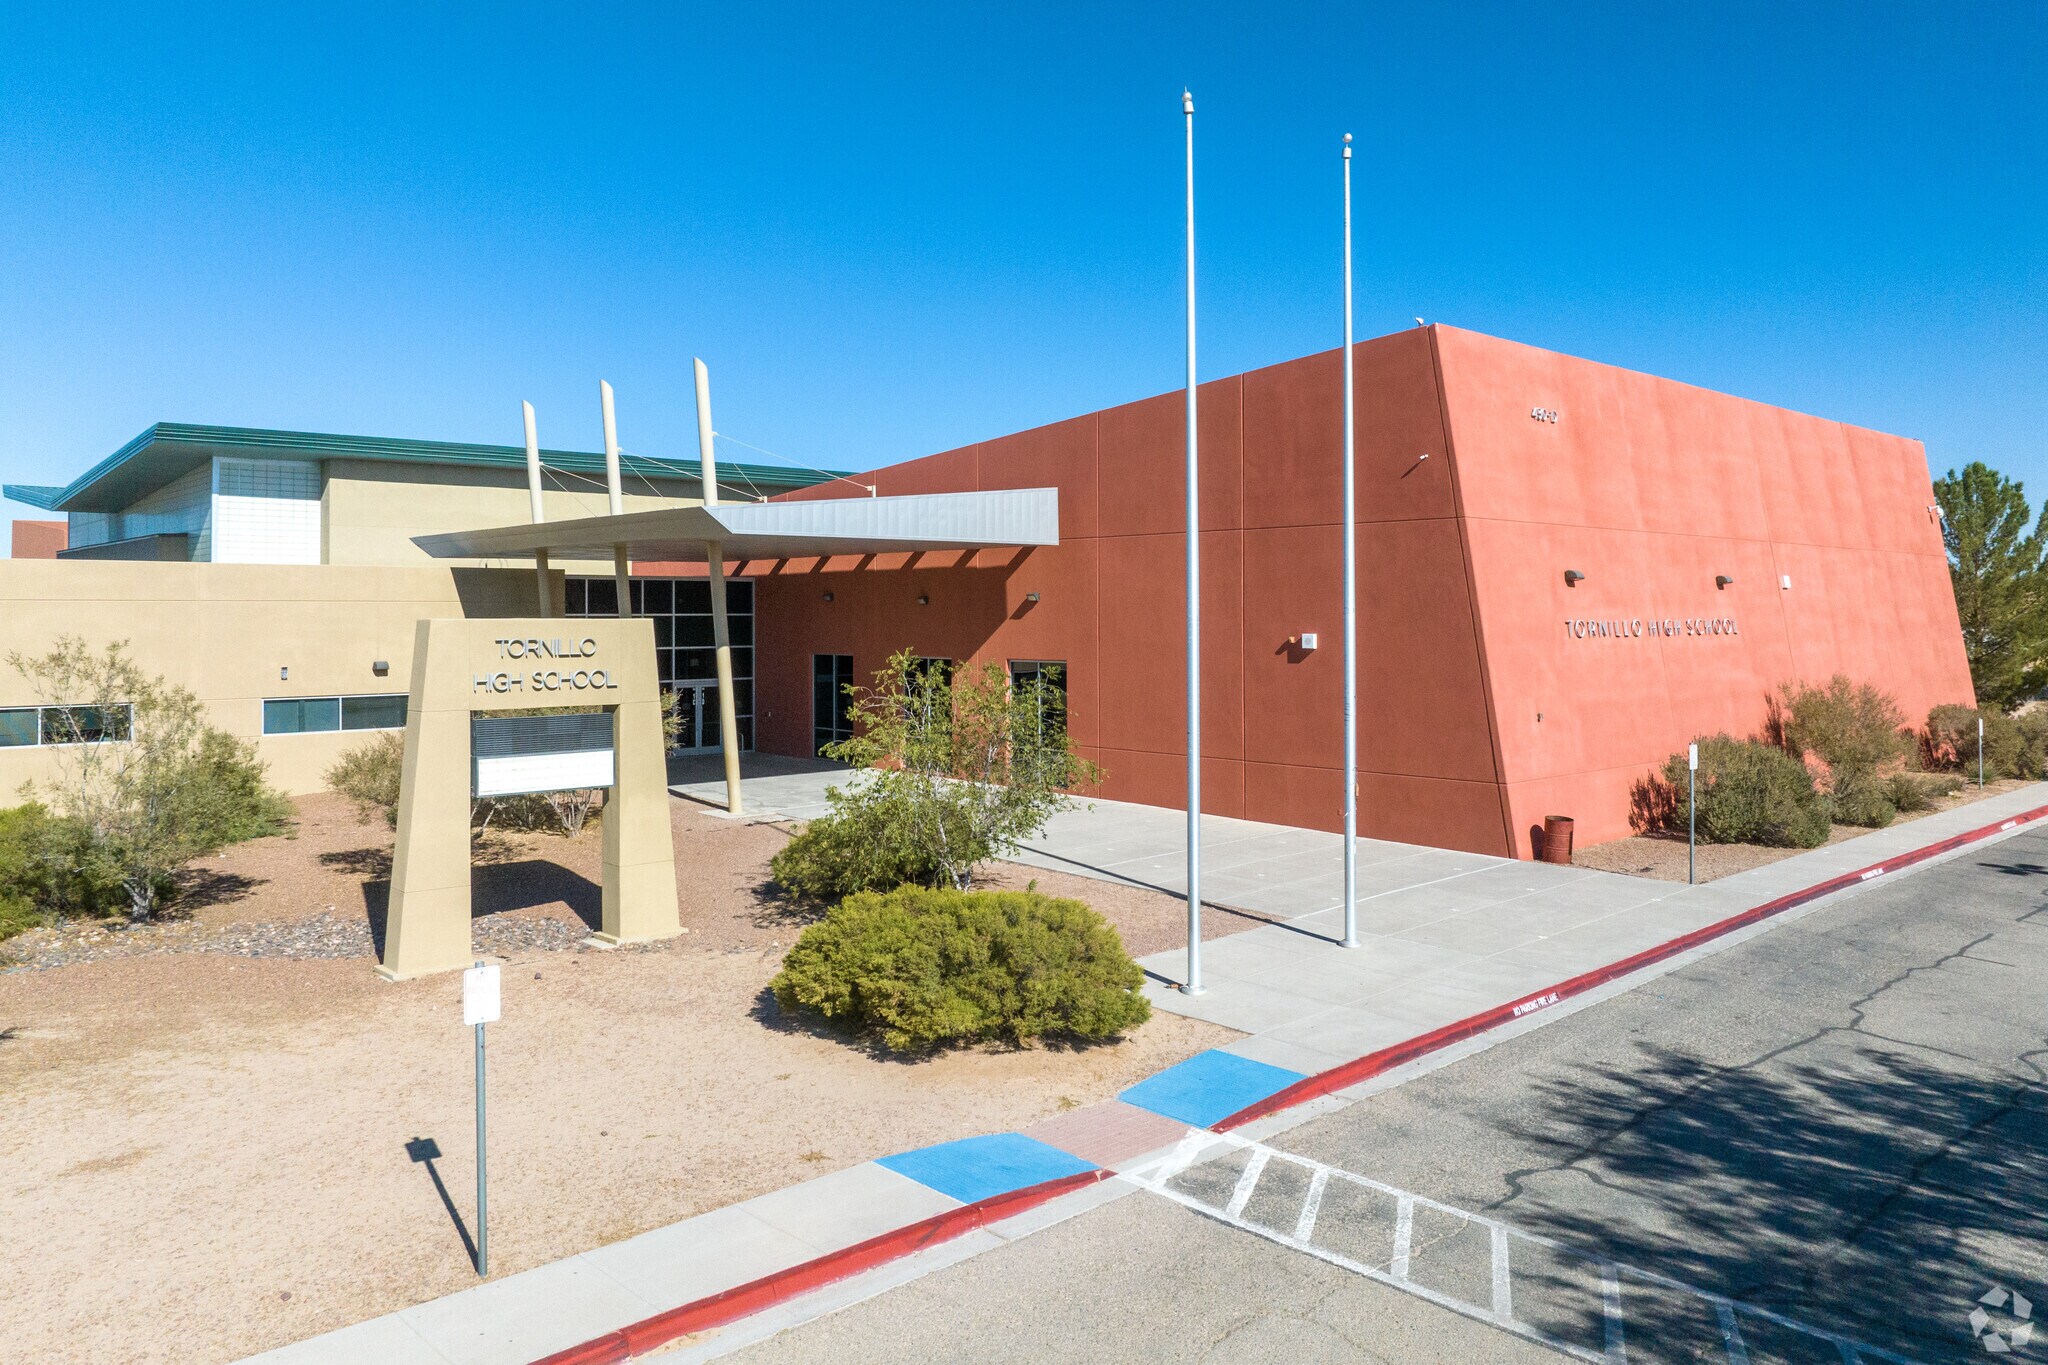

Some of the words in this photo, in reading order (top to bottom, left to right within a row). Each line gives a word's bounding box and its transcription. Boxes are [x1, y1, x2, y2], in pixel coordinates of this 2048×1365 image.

[1565, 619, 1642, 639] TORNILLO
[1648, 618, 1681, 637] HIGH
[1685, 618, 1738, 636] SCHOOL
[495, 637, 597, 659] TORNILLO
[473, 671, 524, 693] HIGH
[532, 670, 618, 691] SCHOOL
